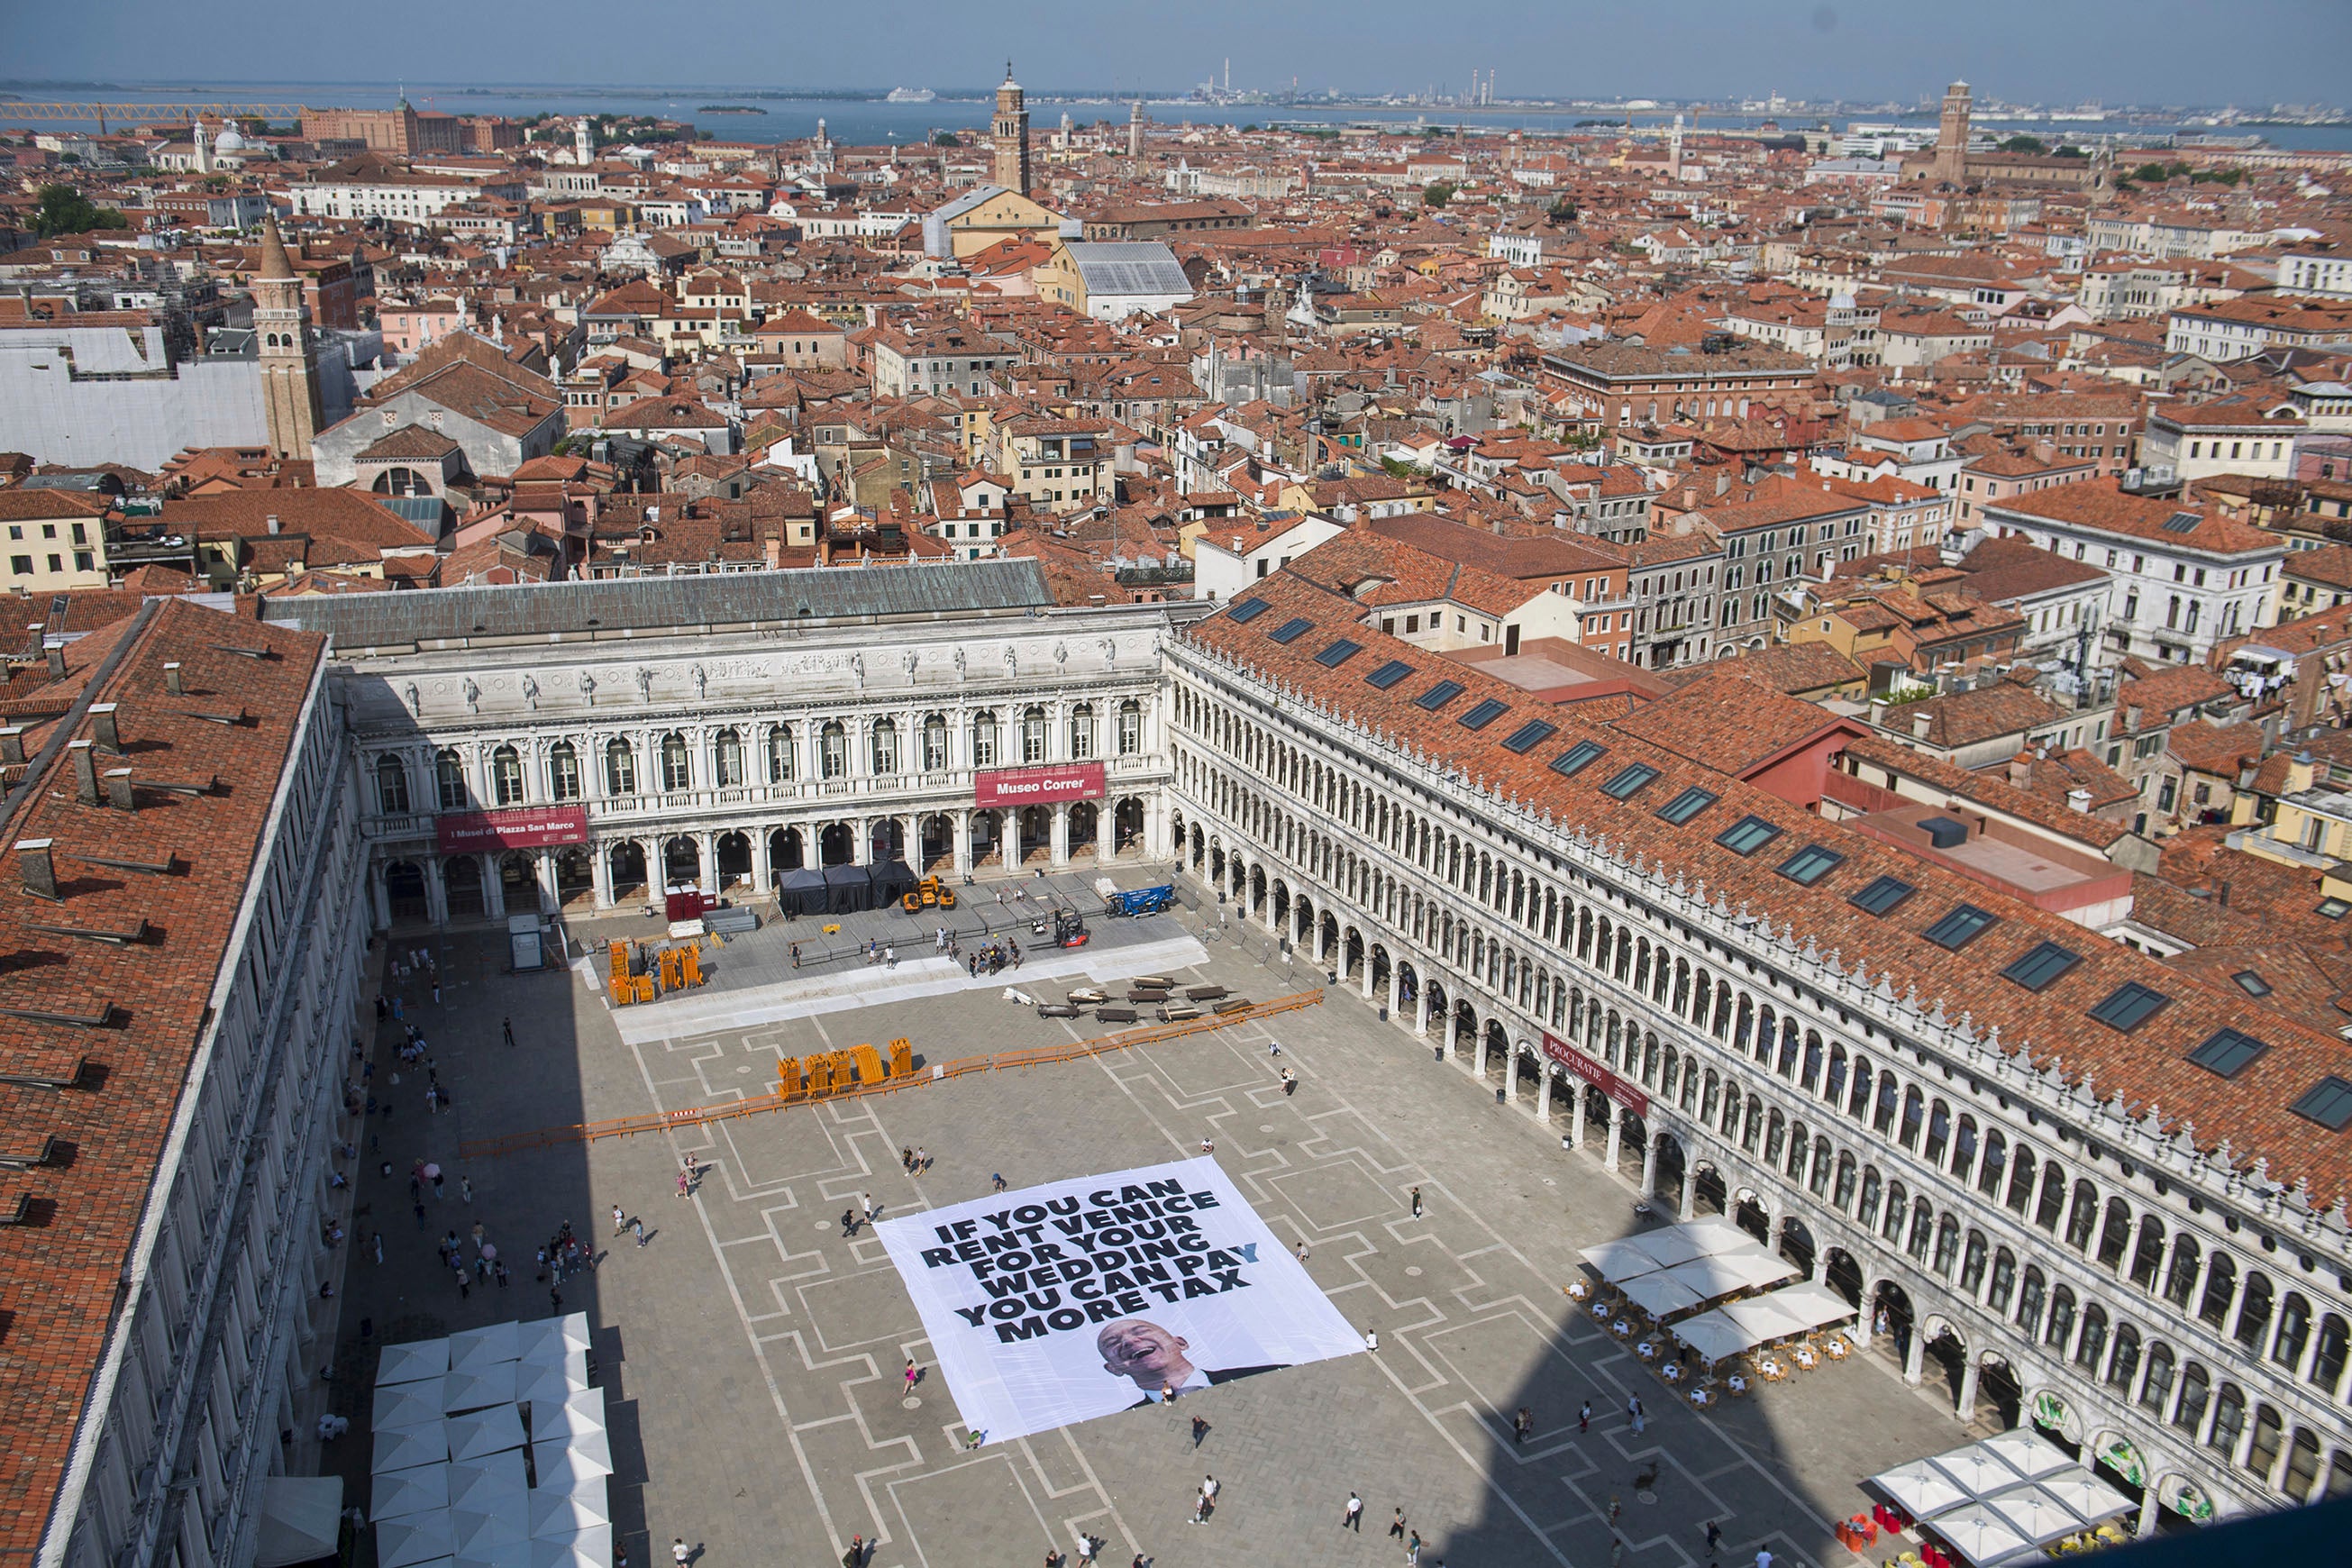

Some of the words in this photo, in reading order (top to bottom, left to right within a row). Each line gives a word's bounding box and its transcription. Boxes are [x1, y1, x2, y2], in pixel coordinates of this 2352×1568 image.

[997, 782, 1040, 795] Museo
[1043, 779, 1085, 790] Correr
[456, 828, 484, 838] Musei
[485, 827, 495, 835] di
[497, 825, 526, 834] Piazza
[527, 824, 544, 832] San
[547, 822, 575, 831] Marco
[1550, 1040, 1602, 1081] PROCURATIE
[920, 1224, 1045, 1269] RENT
[1050, 1190, 1221, 1236] VENICE
[934, 1218, 978, 1244] IF
[981, 1196, 1080, 1231] YOU
[1089, 1178, 1186, 1208] CAN
[969, 1244, 1070, 1281] FOR
[1065, 1215, 1203, 1254] YOUR
[980, 1233, 1211, 1299] WEDDING
[953, 1287, 1062, 1327] YOU
[1070, 1262, 1172, 1300] CAN
[1172, 1242, 1261, 1277] PAY
[993, 1290, 1151, 1344] MORE
[1148, 1268, 1253, 1304] TAX
